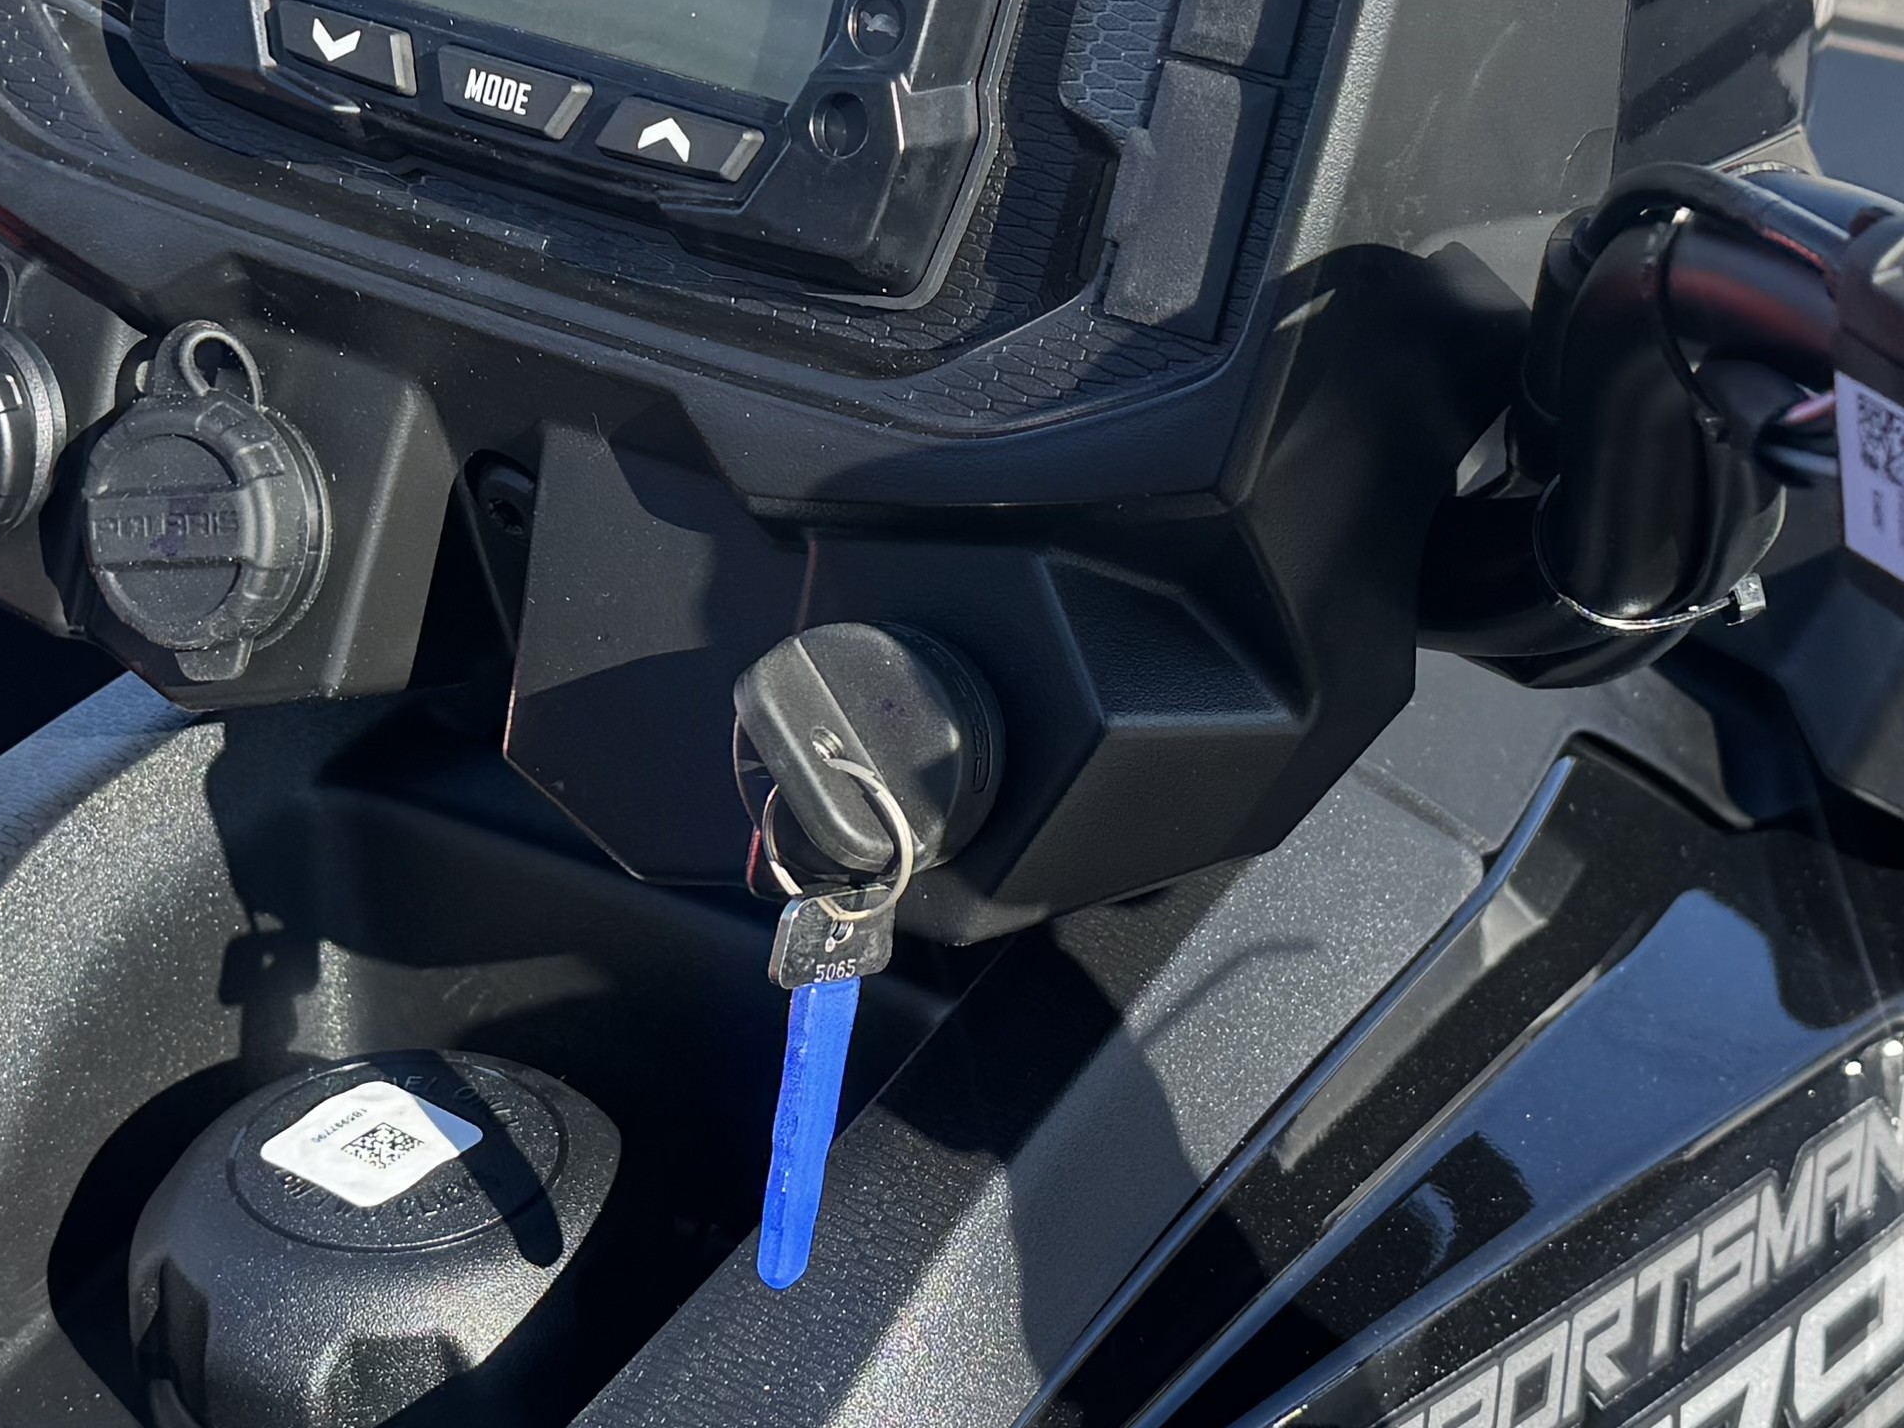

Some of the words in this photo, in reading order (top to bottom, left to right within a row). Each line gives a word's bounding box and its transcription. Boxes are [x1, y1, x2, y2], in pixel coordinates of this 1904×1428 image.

[463, 68, 532, 117] MODE
[92, 509, 240, 540] POLARIS
[814, 957, 857, 983] 5065
